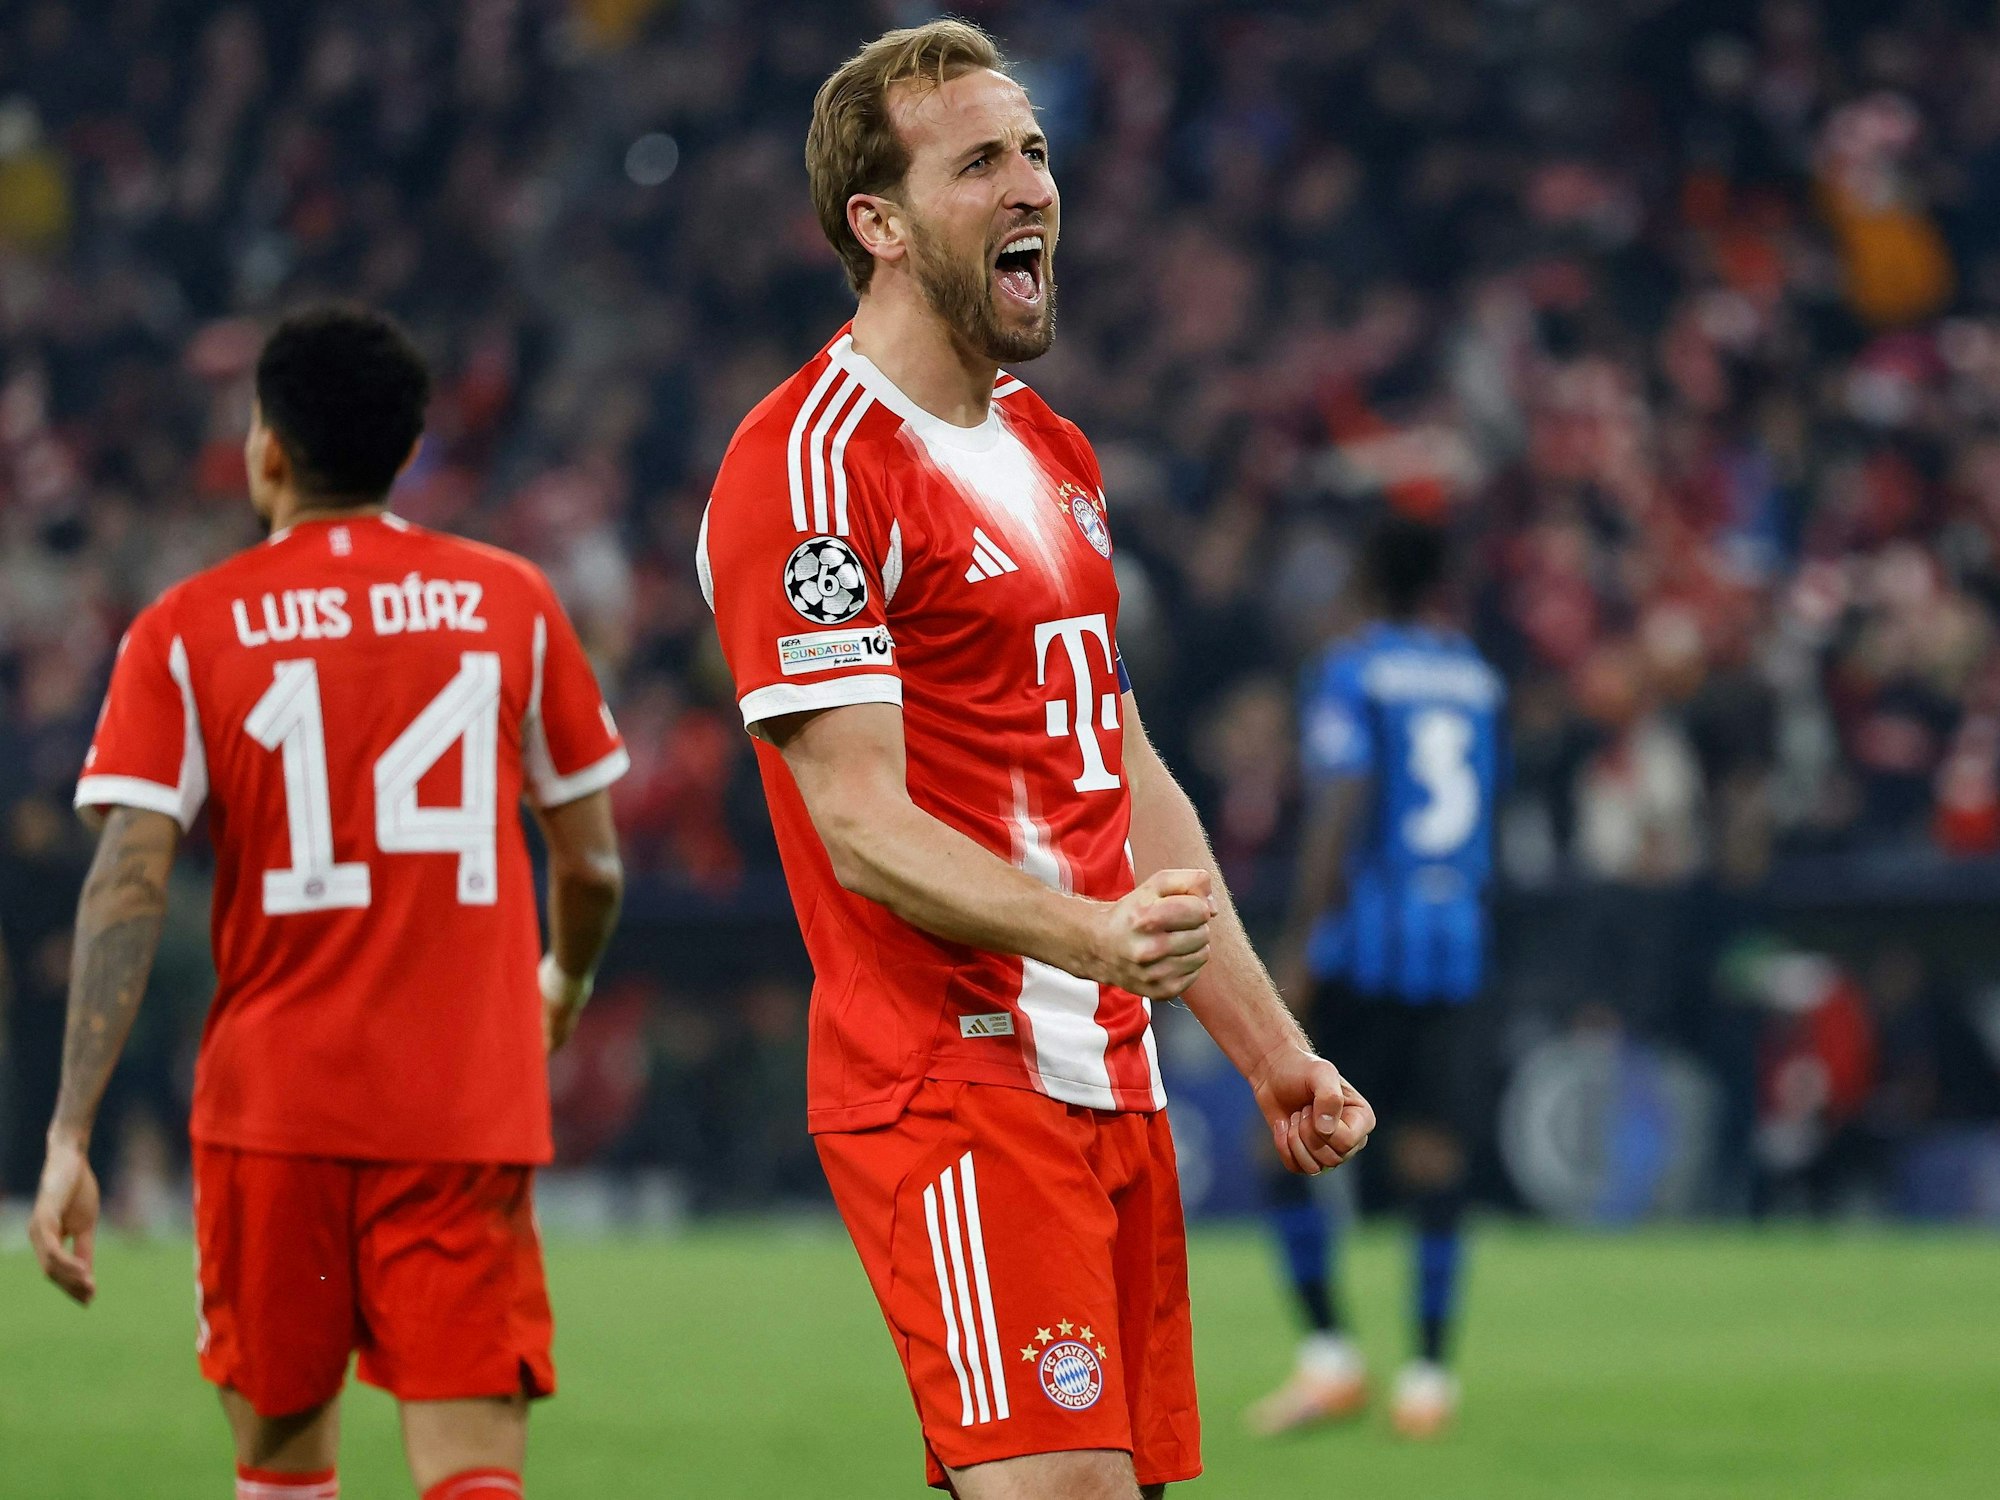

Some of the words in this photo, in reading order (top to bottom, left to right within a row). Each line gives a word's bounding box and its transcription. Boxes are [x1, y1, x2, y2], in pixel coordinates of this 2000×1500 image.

[817, 564, 840, 597] 6
[231, 587, 353, 648] LUIS
[369, 571, 488, 636] DÍAZ
[781, 638, 801, 648] UEFA
[783, 643, 860, 661] FOUNDATION
[861, 636, 888, 655] 10
[833, 658, 841, 666] for
[243, 651, 500, 916] 14
[1044, 1356, 1057, 1373] FC
[1055, 1345, 1097, 1372] BAYERN
